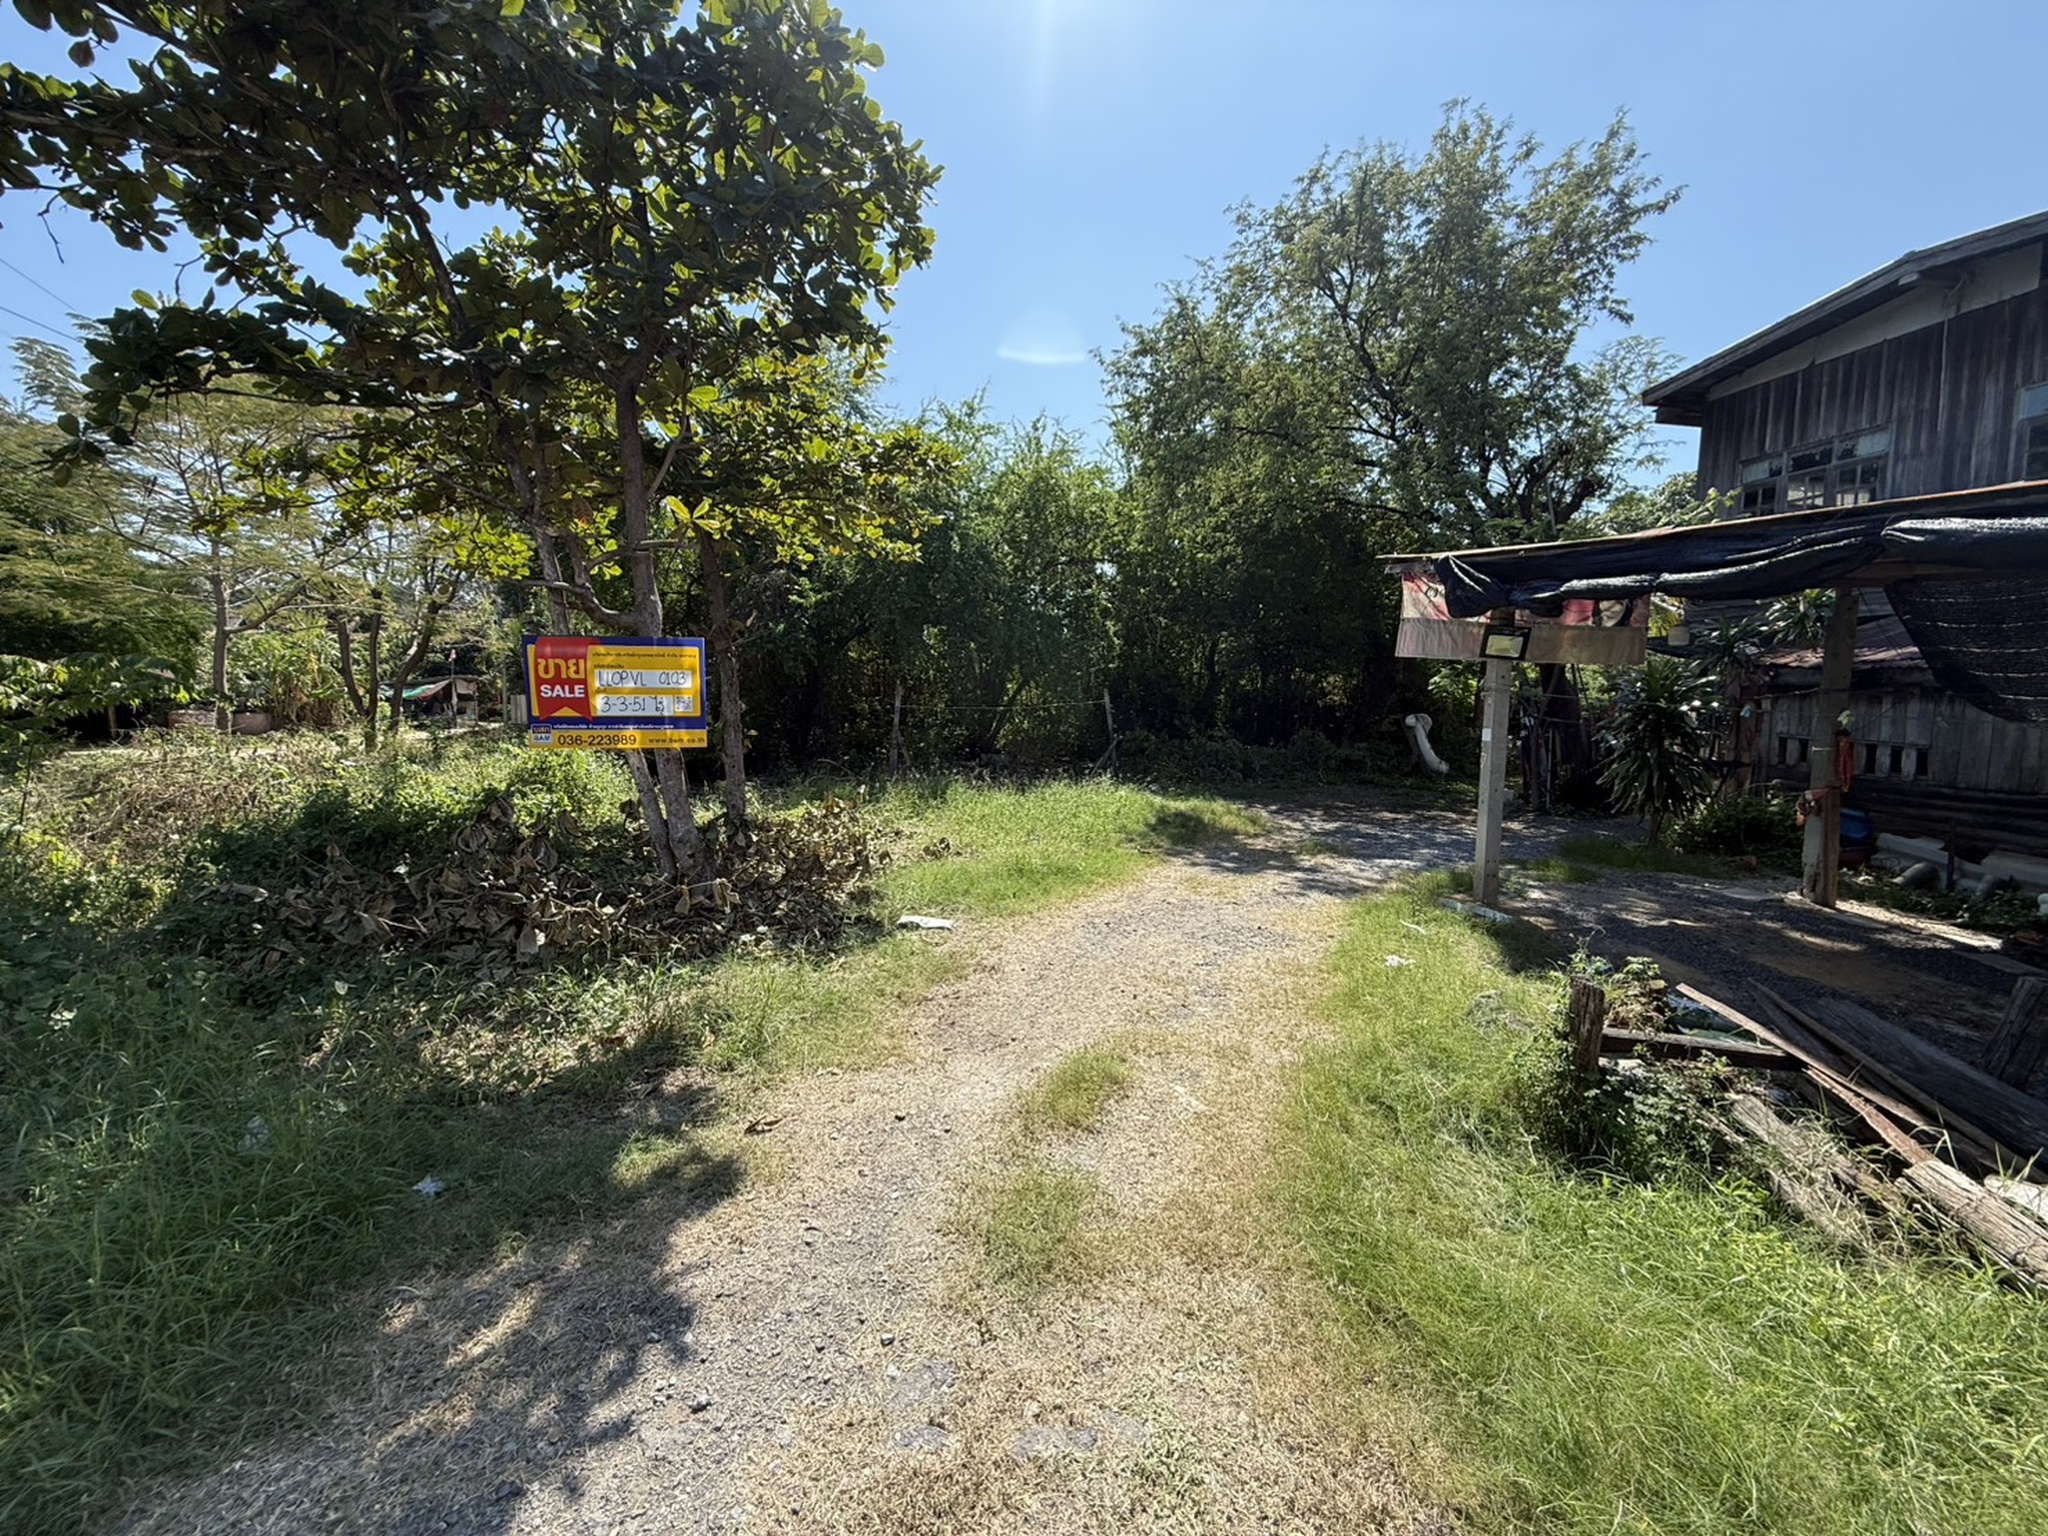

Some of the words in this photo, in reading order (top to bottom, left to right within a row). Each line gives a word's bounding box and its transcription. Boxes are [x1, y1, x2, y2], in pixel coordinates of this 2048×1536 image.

[537, 657, 585, 679] ขาย
[540, 684, 586, 698] SALE
[557, 734, 637, 746] 036-223989
